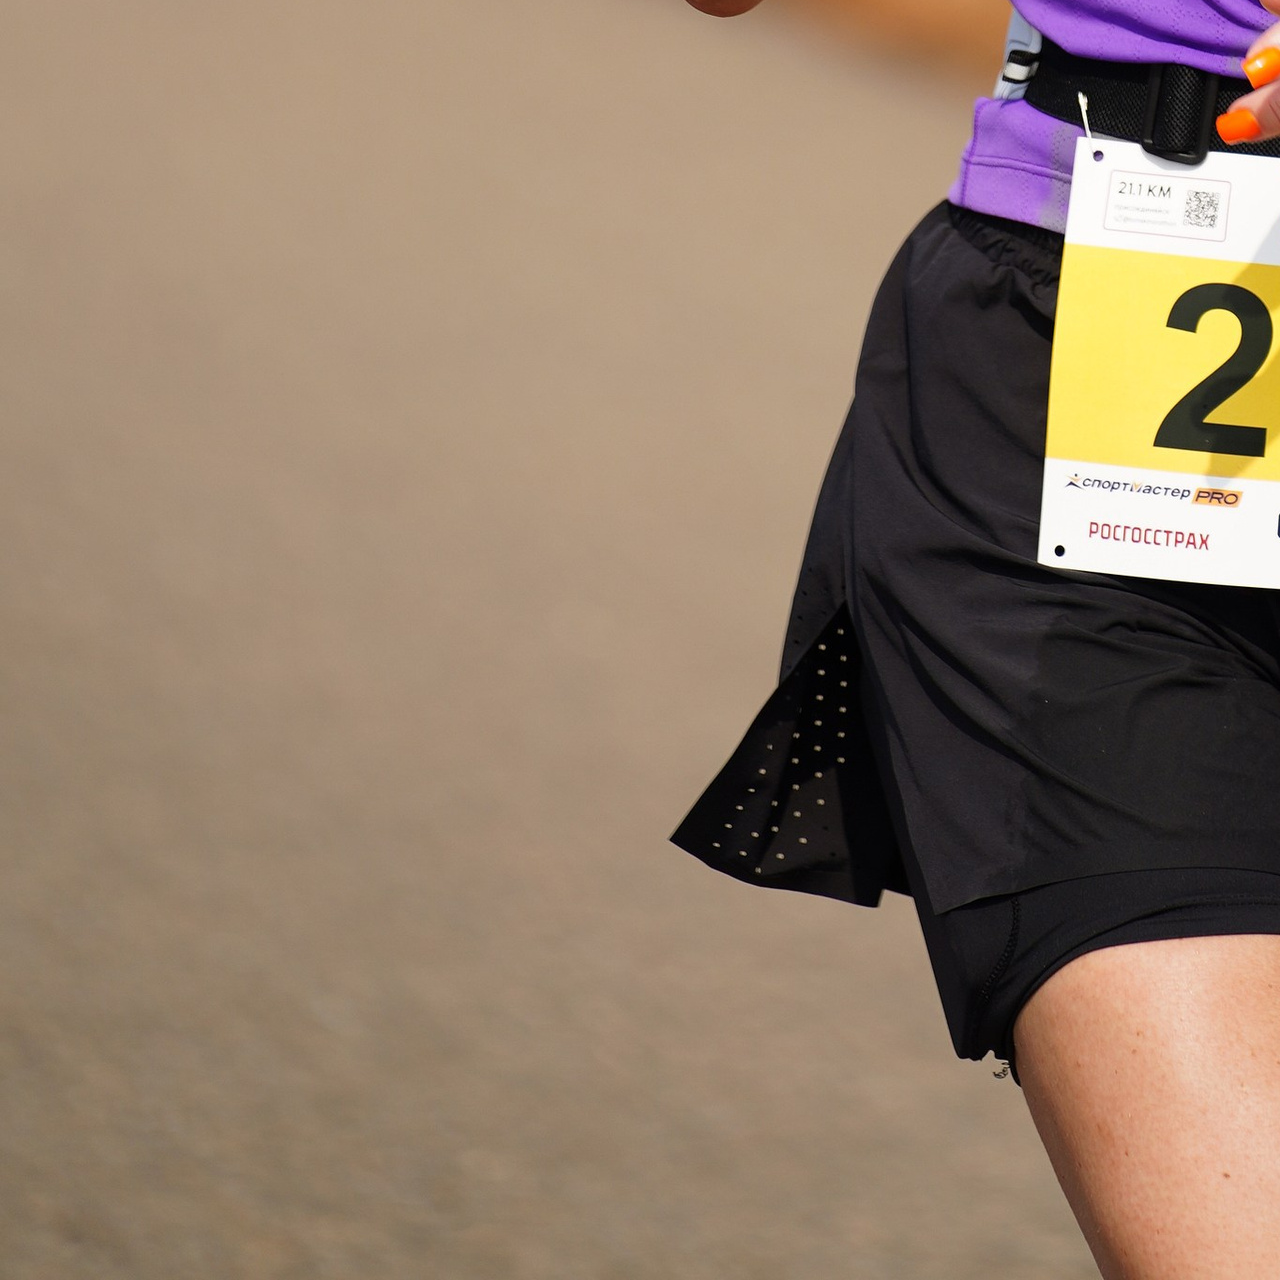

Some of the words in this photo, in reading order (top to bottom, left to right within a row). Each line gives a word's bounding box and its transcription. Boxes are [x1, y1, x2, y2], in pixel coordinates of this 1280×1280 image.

[1118, 181, 1143, 197] 21.1
[1195, 490, 1239, 506] PRO
[1089, 522, 1210, 550] РОСГОССТРАХ
